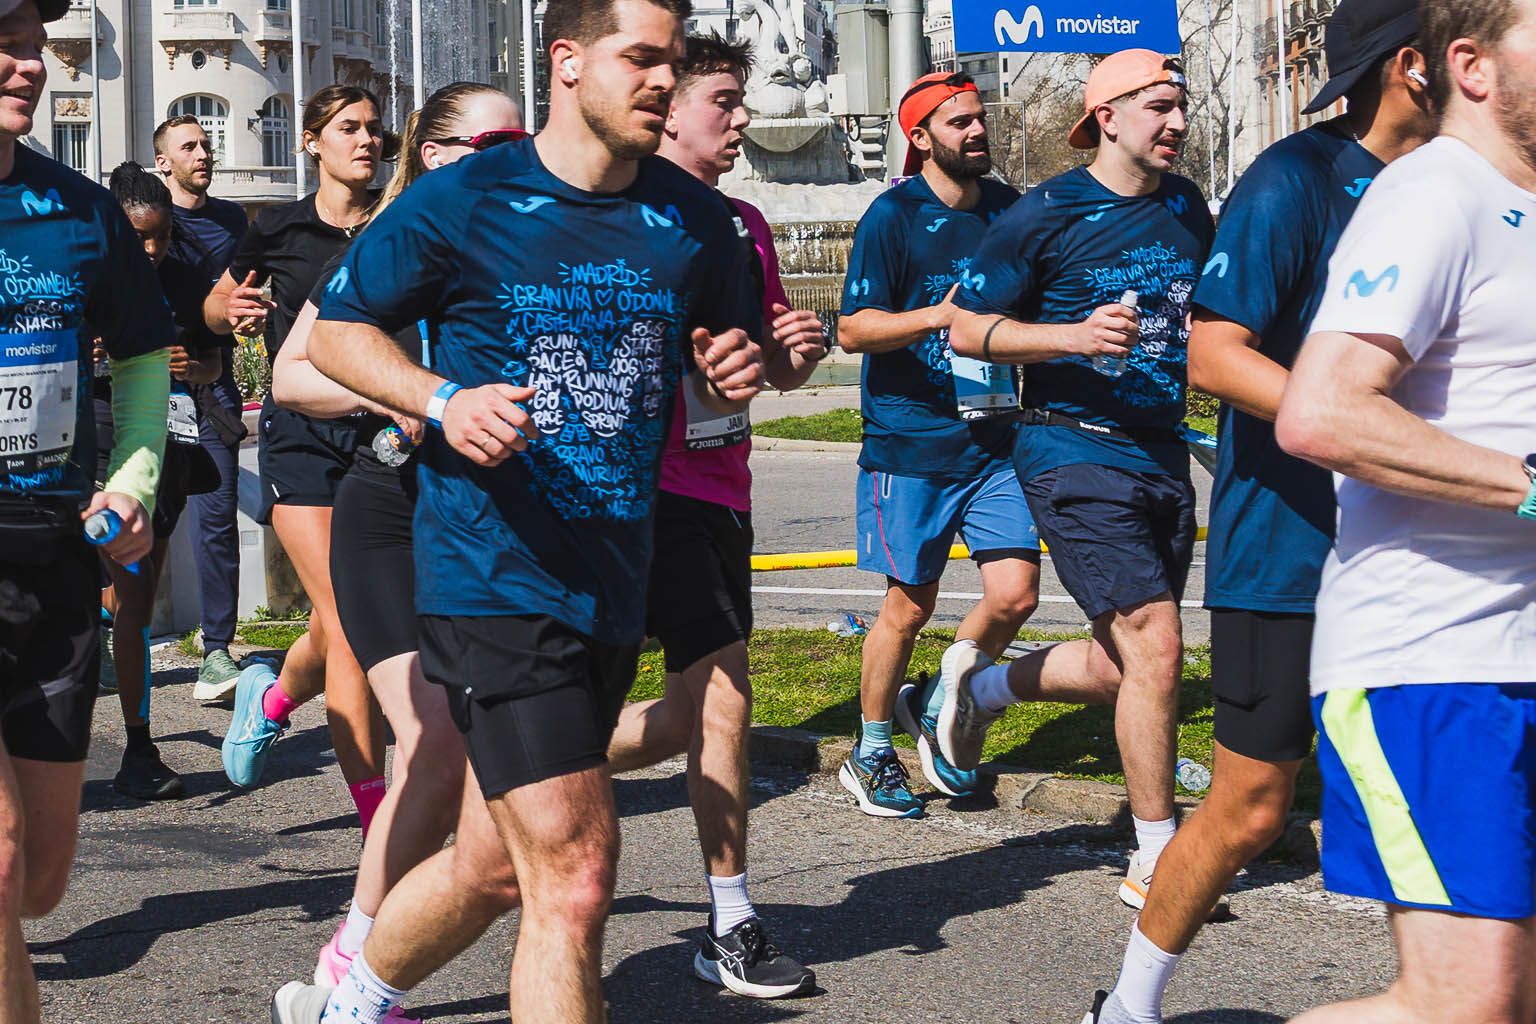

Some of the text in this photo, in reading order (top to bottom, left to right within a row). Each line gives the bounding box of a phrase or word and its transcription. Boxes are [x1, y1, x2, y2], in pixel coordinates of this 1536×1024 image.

[1055, 13, 1141, 35] movistar
[1129, 244, 1171, 264] MADRID
[4, 270, 77, 297] O'DONNELL
[571, 261, 640, 287] MADRID
[1095, 266, 1127, 284] GRAN
[513, 283, 563, 310] GRAN
[522, 309, 617, 335] CASTELLANA
[5, 342, 58, 358] movistar
[726, 415, 744, 431] JAN
[552, 444, 606, 465] BRAVO
